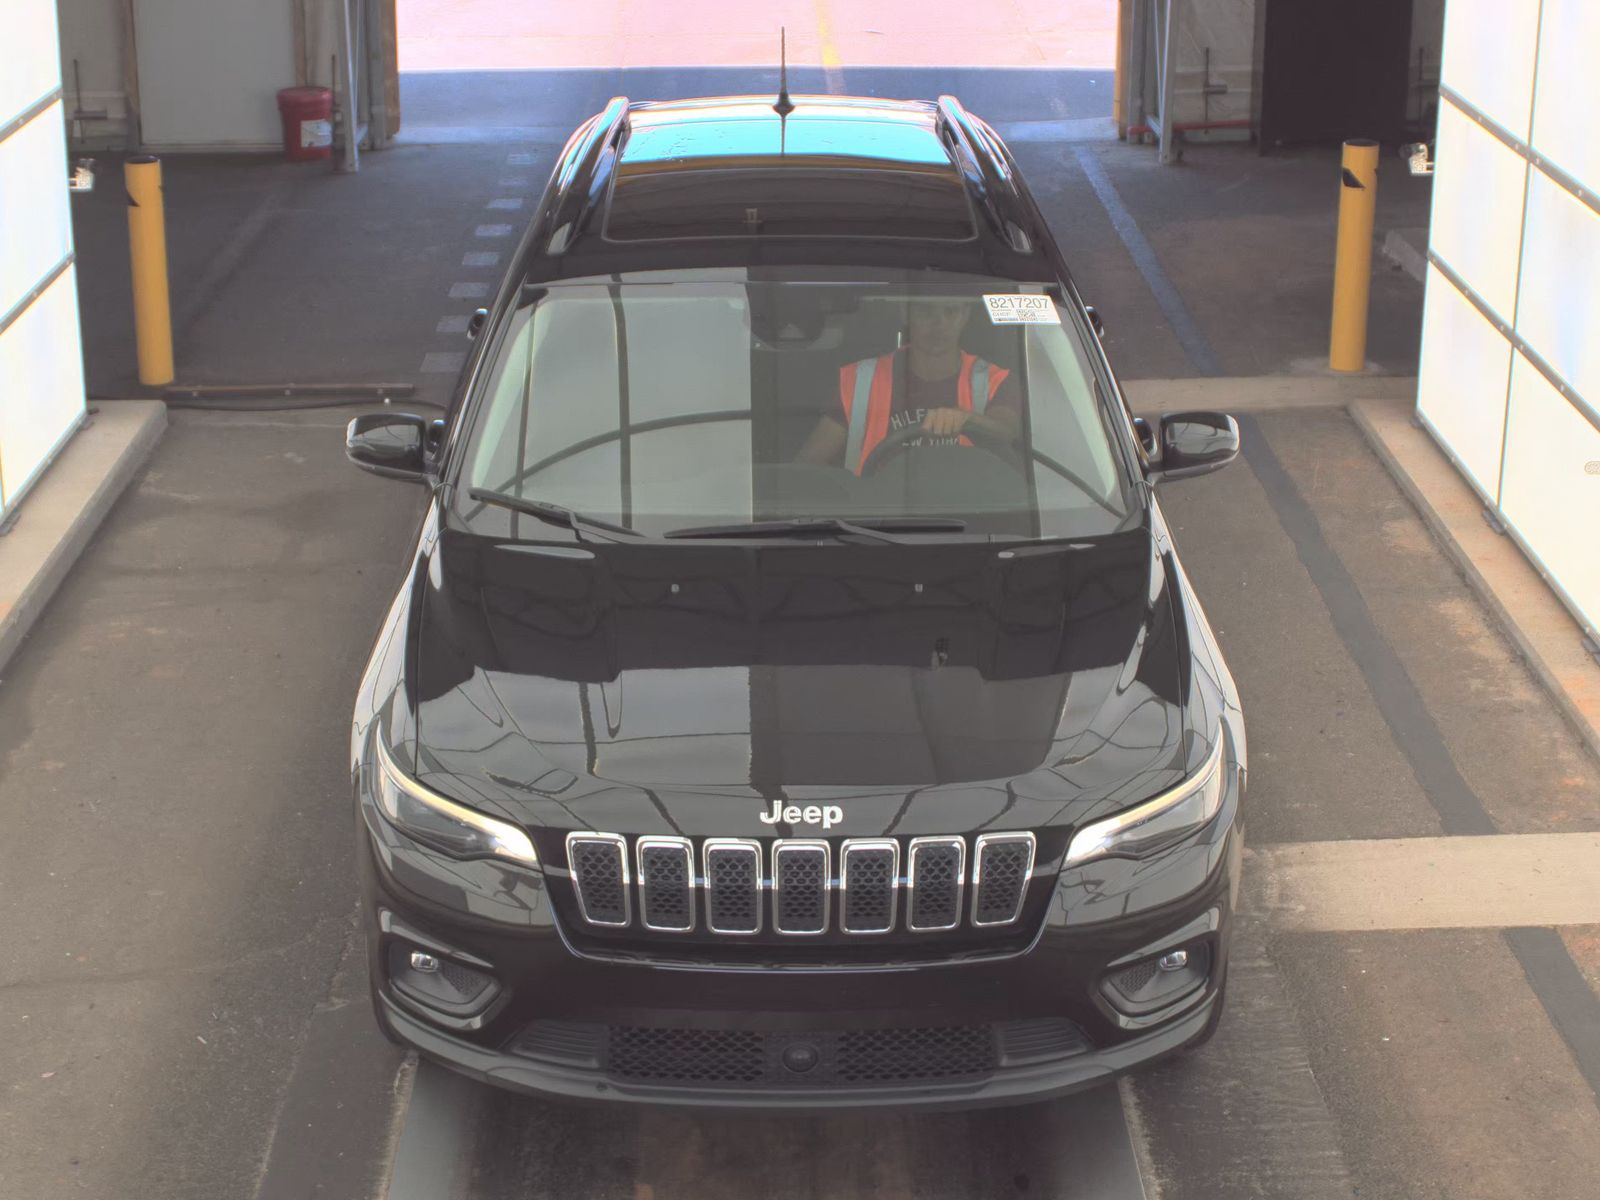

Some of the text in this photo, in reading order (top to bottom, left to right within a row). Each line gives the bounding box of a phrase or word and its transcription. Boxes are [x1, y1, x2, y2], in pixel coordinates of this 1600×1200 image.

[989, 297, 1048, 309] 8217207
[890, 408, 926, 430] HILF
[759, 799, 844, 829] Jeep
